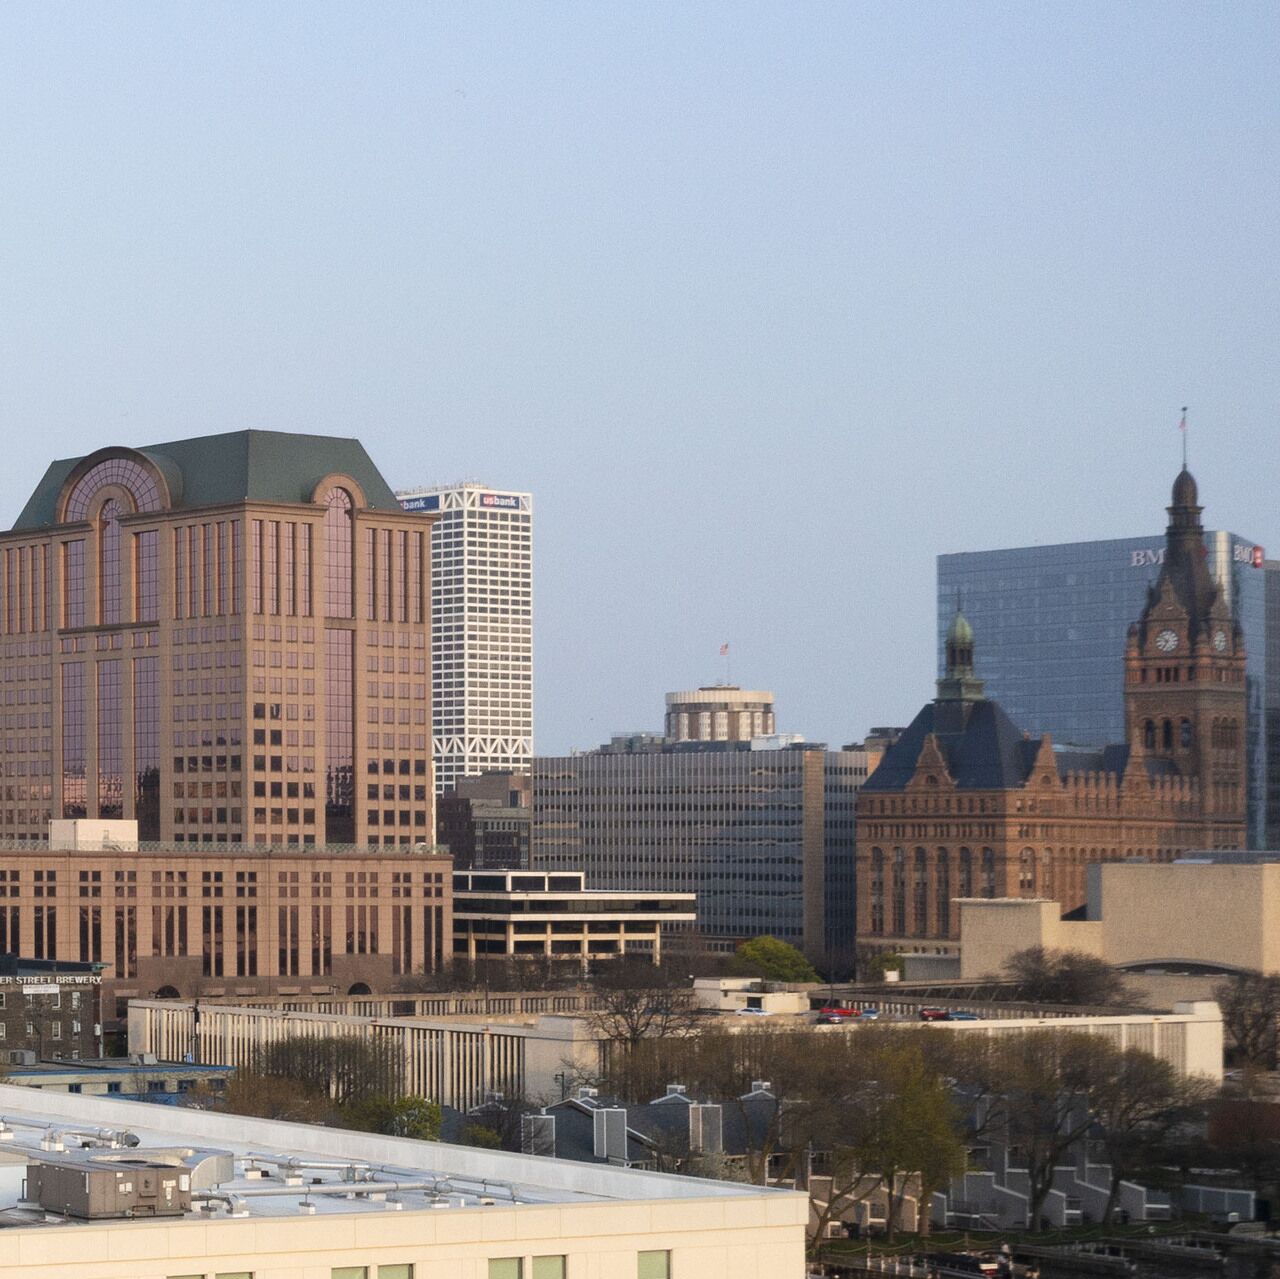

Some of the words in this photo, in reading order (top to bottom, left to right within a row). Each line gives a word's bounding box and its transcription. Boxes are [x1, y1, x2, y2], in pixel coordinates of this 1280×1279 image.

[483, 495, 517, 507] usbank
[1130, 548, 1166, 567] BM
[15, 975, 52, 985] STREET
[55, 975, 103, 985] BREWERY
